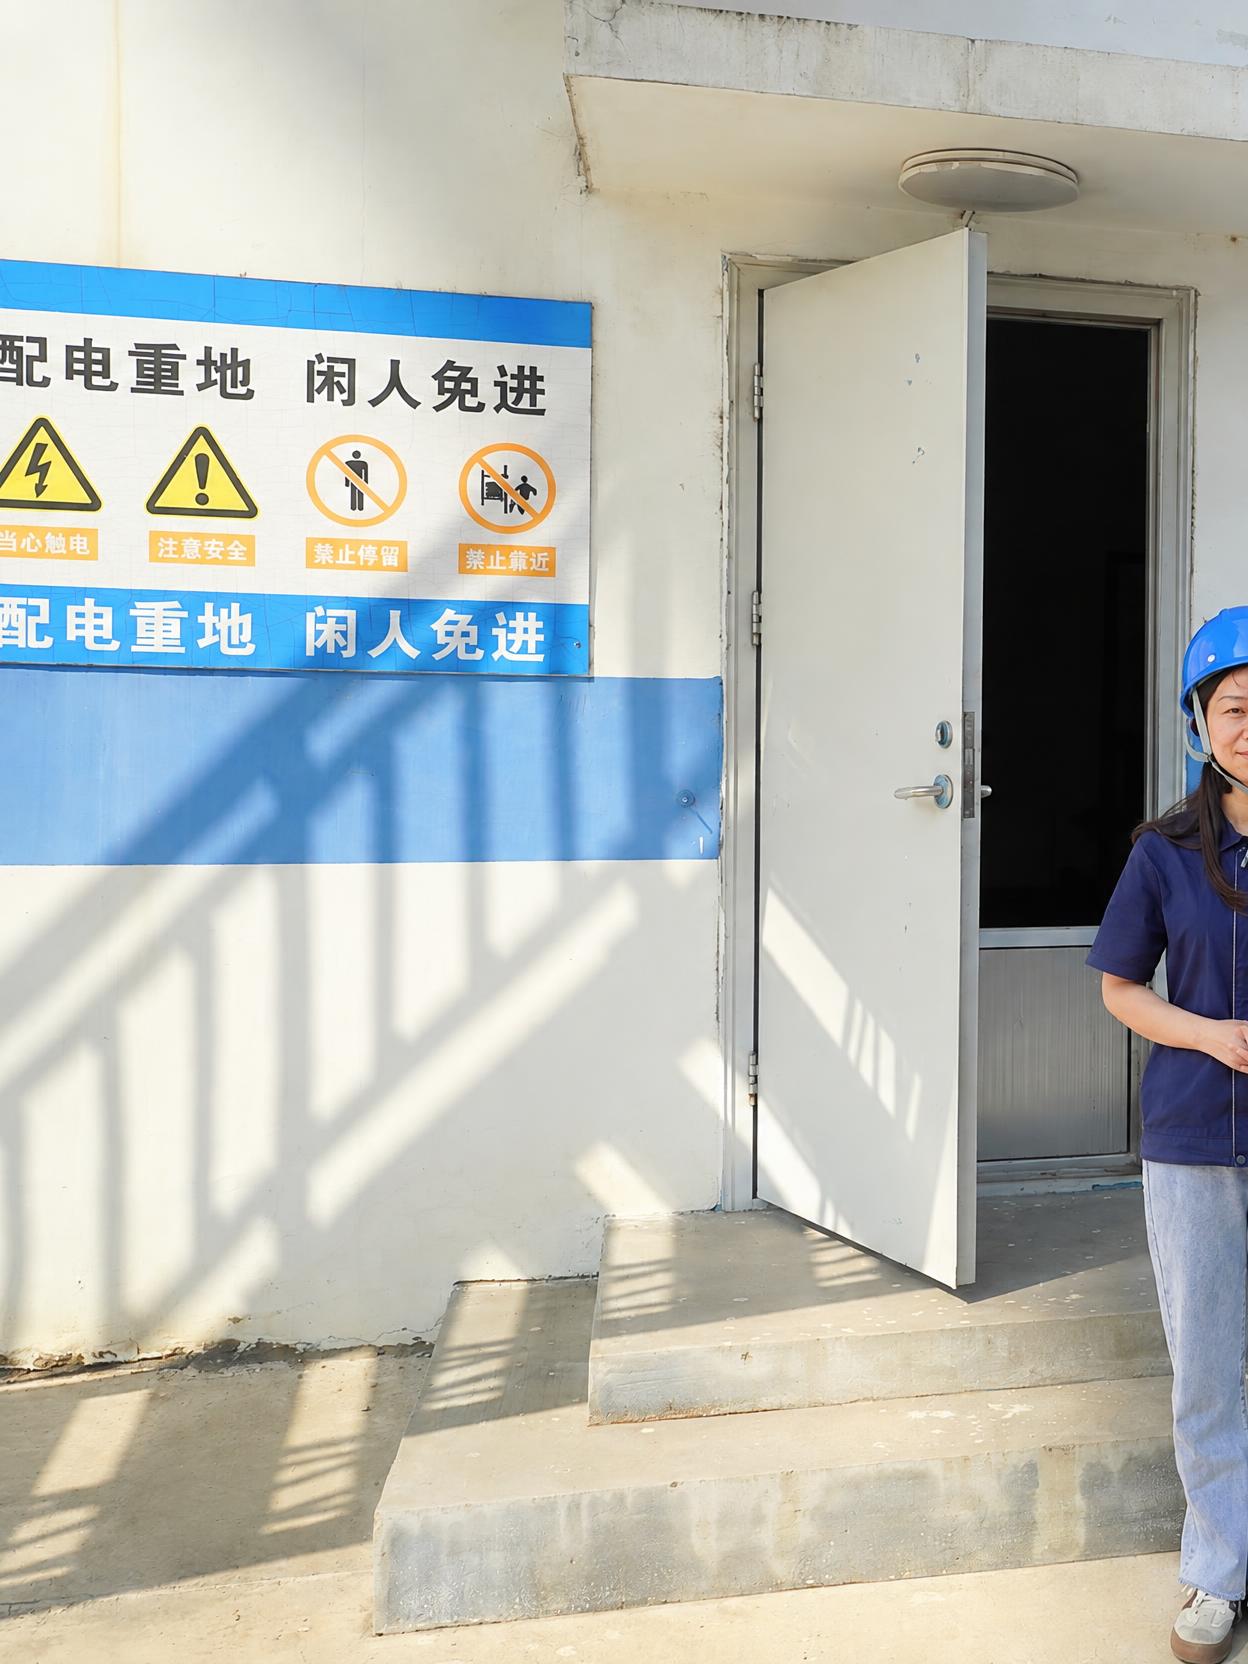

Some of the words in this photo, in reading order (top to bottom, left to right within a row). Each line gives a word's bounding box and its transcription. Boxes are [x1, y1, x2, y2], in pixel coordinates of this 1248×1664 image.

[0, 333, 256, 401] 配电重地
[305, 352, 548, 417] 闲人免进
[0, 529, 91, 555] 当心触电
[157, 536, 248, 561] 注意安全
[313, 543, 400, 568] 禁止停留
[465, 548, 550, 572] 禁止靠近
[0, 596, 256, 656] 配电重地
[304, 604, 546, 663] 闲人免进
